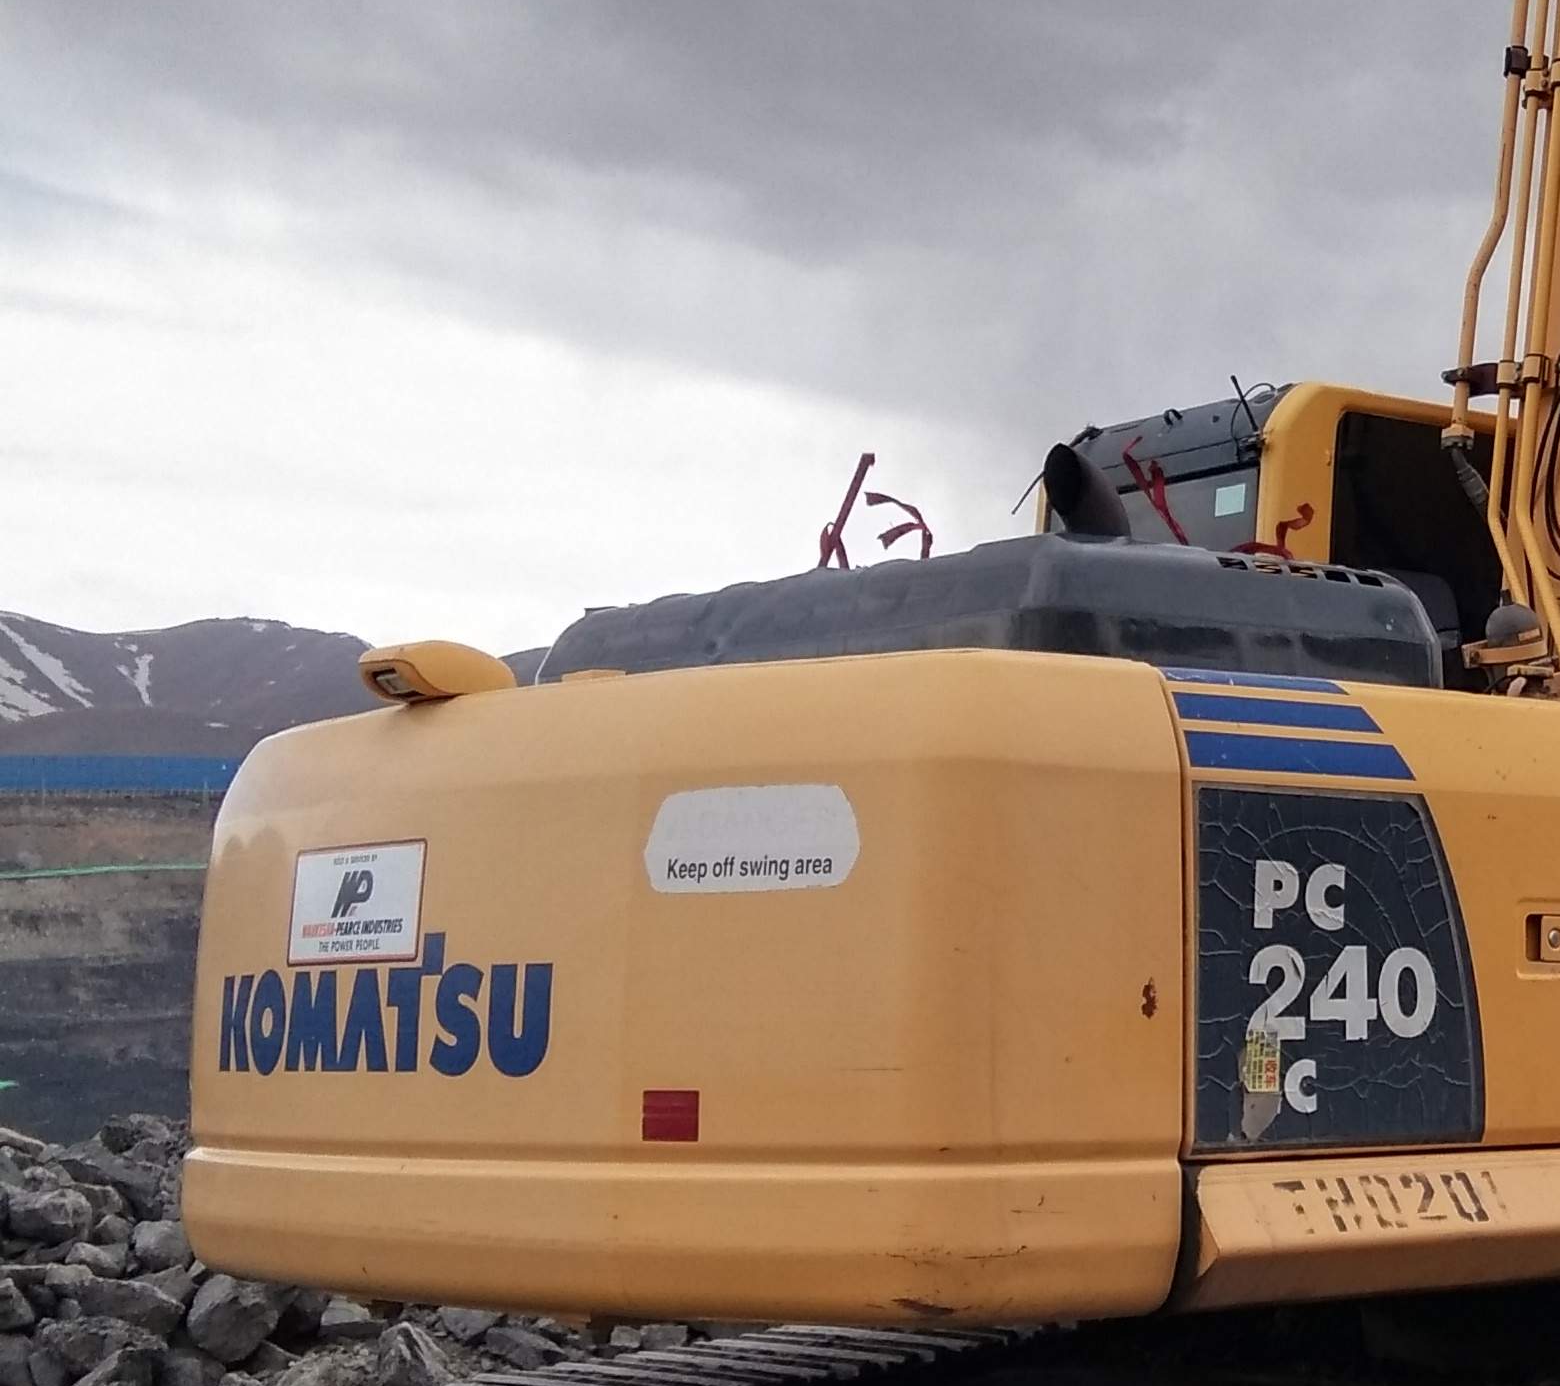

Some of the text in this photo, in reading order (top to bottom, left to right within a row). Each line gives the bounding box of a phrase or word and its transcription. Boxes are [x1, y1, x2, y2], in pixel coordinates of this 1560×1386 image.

[667, 854, 833, 884] Keep off swing area
[1253, 860, 1346, 931] PC
[331, 939, 353, 952] POWER
[356, 938, 380, 951] PEOPLE
[361, 918, 403, 935] INDUSTRIES
[219, 932, 554, 1077] KOMATSU
[1246, 945, 1438, 1041] 240
